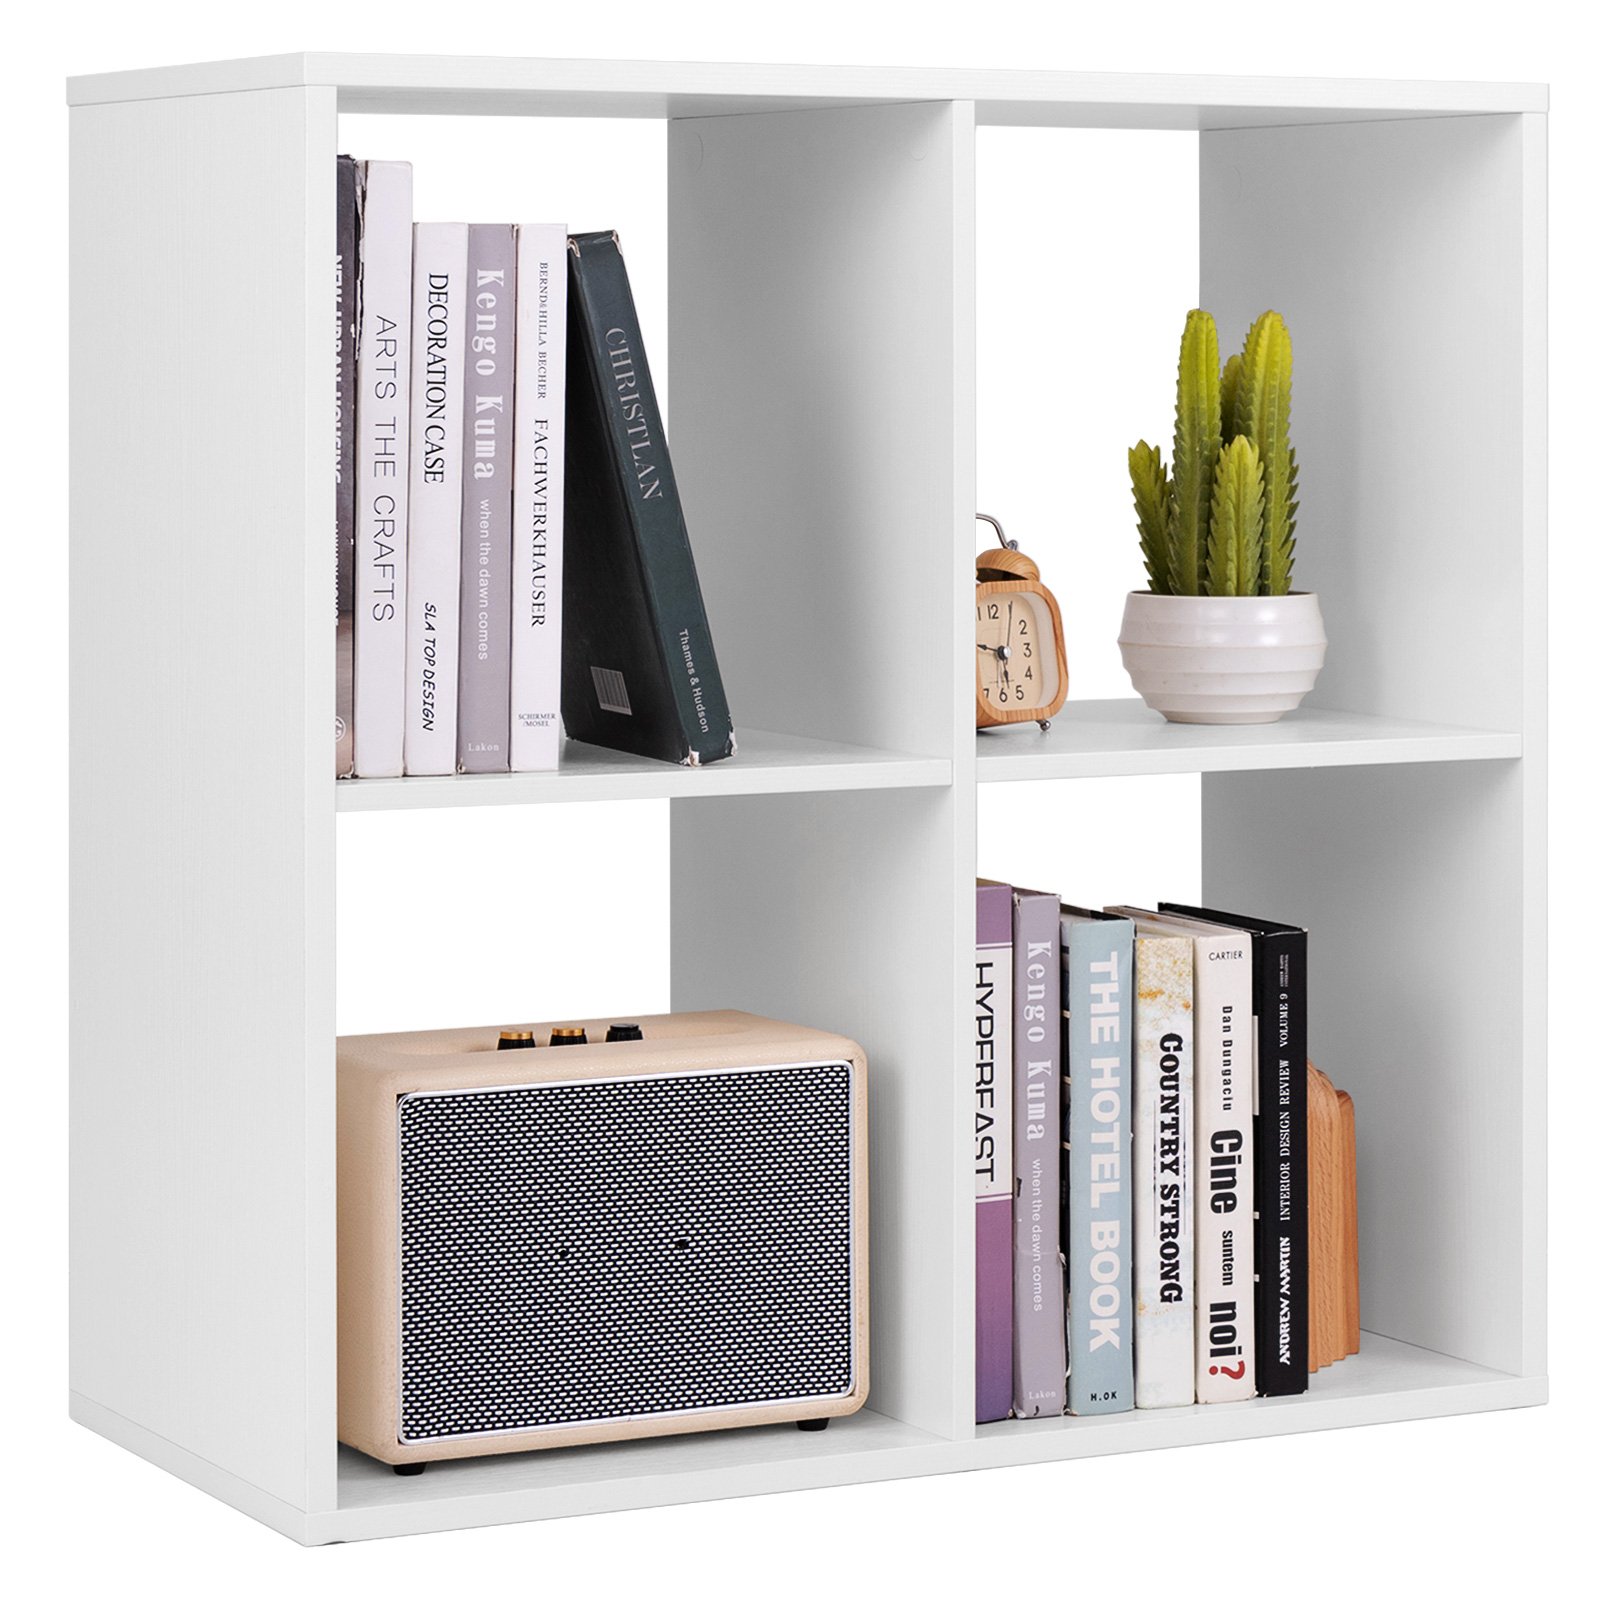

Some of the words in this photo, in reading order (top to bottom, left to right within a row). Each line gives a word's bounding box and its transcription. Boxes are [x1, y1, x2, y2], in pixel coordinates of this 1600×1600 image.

[471, 269, 505, 376] Kengo
[374, 314, 398, 400] ARTS
[425, 273, 449, 420] DECORATION
[537, 351, 547, 399] BECHER
[373, 416, 397, 478] THE
[424, 424, 446, 484] CASE
[474, 394, 504, 480] Kuma
[479, 498, 492, 539] when
[531, 419, 549, 627] FACHWERKHAUSER
[372, 494, 396, 622] CRAFTS
[479, 541, 492, 566] the
[478, 568, 492, 608] dawn
[987, 604, 999, 619] 12
[424, 602, 437, 631] SLA
[478, 612, 489, 661] comes
[1018, 619, 1028, 635] 2
[423, 637, 436, 667] TOP
[679, 628, 696, 675] Thames
[1023, 642, 1032, 658] 3
[1024, 665, 1033, 680] 4
[422, 668, 436, 732] DESIGN
[690, 677, 700, 686] &
[983, 688, 990, 699] 7
[999, 688, 1008, 703] 6
[1015, 684, 1025, 701] 5
[692, 686, 709, 733] Hudson
[468, 742, 500, 752] Lakon
[1208, 950, 1243, 961] CARTIER
[1023, 940, 1052, 1043] Kengo
[1089, 950, 1120, 1045] THE
[1222, 1005, 1233, 1033] Dan
[1279, 1003, 1289, 1048] VOLUME
[1026, 1059, 1052, 1141] Kuma
[1159, 1032, 1184, 1177] COUNTRY
[1279, 1059, 1290, 1105] REVIEW
[1090, 1056, 1121, 1209] HOTEL
[1279, 1111, 1290, 1157] DESIGN
[1031, 1158, 1043, 1196] when
[1210, 1129, 1243, 1214] Cine
[1279, 1162, 1291, 1221] INTERIOR
[1031, 1199, 1043, 1222] the
[1031, 1224, 1043, 1262] dawn
[1159, 1183, 1183, 1304] STRONG
[1221, 1230, 1235, 1286] suntem
[1279, 1236, 1291, 1296] MARTIN
[1032, 1265, 1043, 1312] comes
[1089, 1219, 1121, 1353] BOOK
[1208, 1301, 1246, 1380] noi?
[1279, 1298, 1291, 1366] ANDREW
